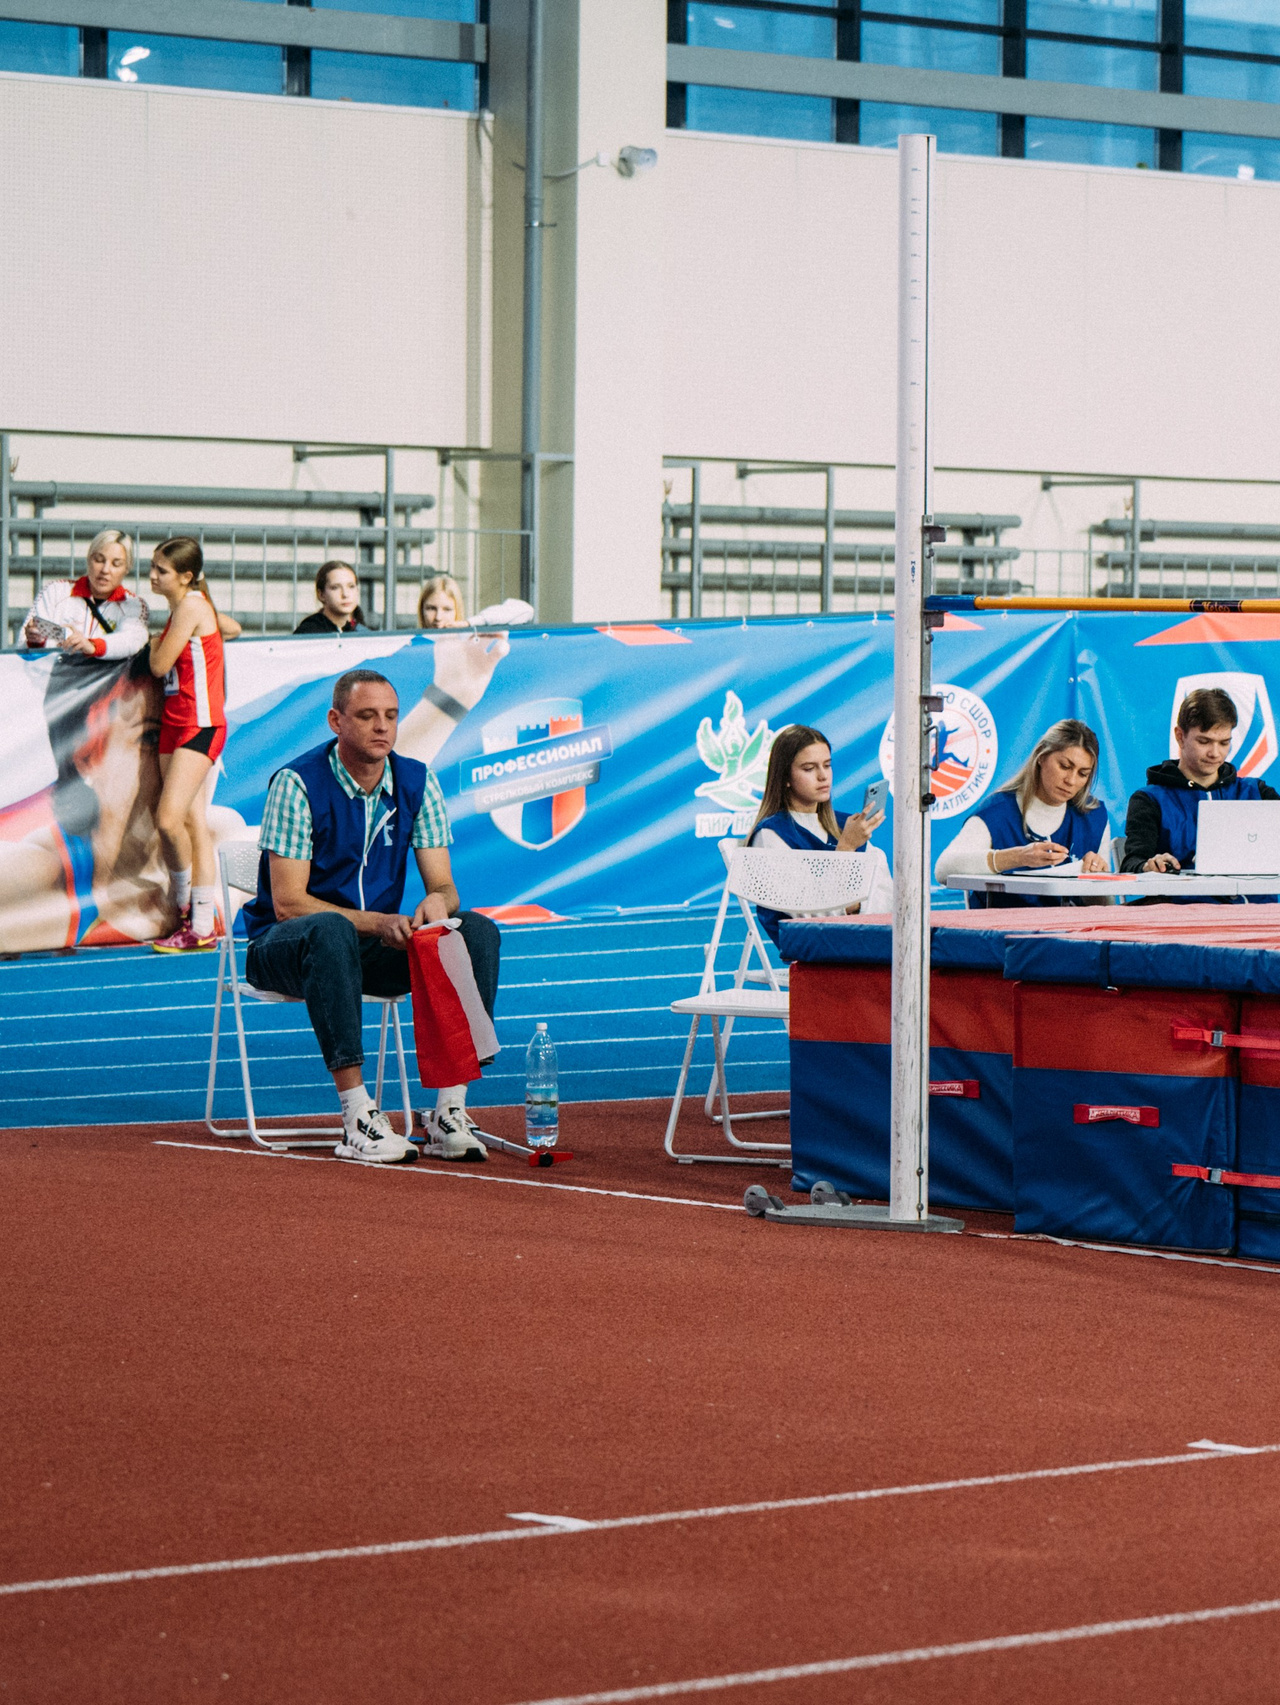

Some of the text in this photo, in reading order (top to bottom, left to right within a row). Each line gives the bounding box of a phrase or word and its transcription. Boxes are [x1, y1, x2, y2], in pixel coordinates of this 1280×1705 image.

[960, 697, 992, 739] СШОР
[472, 737, 603, 783] ПРОФЕССИОНАЛ
[545, 769, 594, 790] КОМПЛЕКС
[941, 762, 989, 811] АТЛЕТИКЕ
[700, 816, 730, 834] МИР
